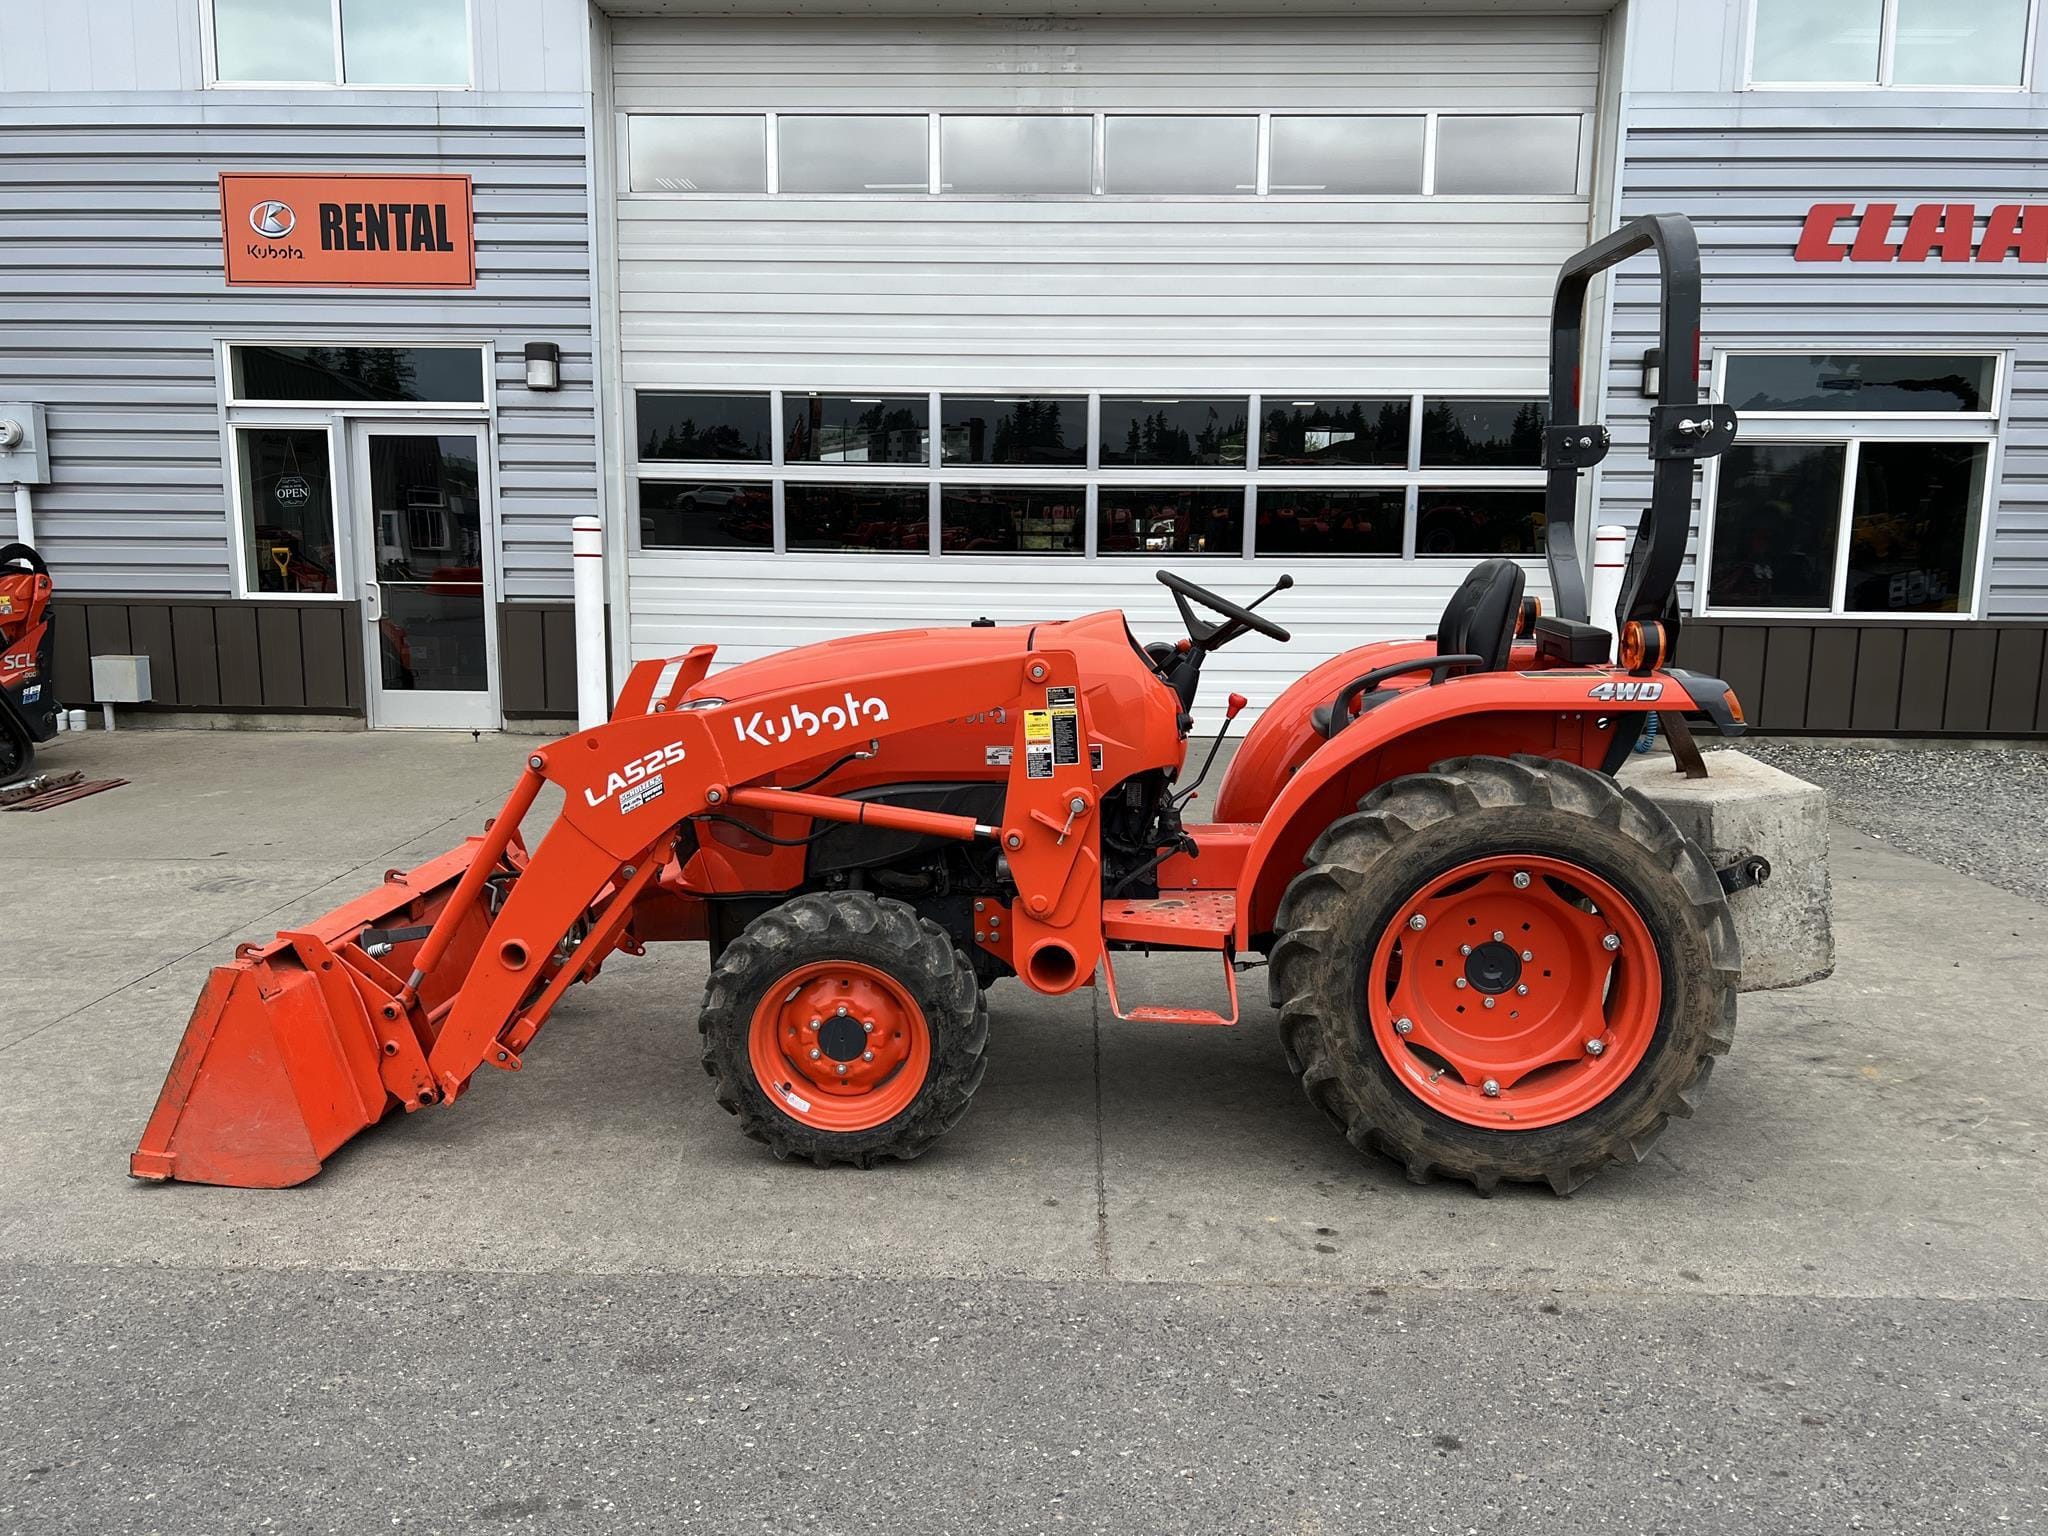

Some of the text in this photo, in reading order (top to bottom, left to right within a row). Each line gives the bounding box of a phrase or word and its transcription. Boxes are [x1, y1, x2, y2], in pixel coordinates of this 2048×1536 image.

[319, 203, 454, 251] RENTAL
[247, 244, 303, 260] Kubota
[276, 488, 308, 498] OPEN
[3, 653, 35, 670] SCL
[1588, 682, 1664, 701] 4WD
[733, 692, 889, 746] Kubota
[583, 741, 686, 807] LA525
